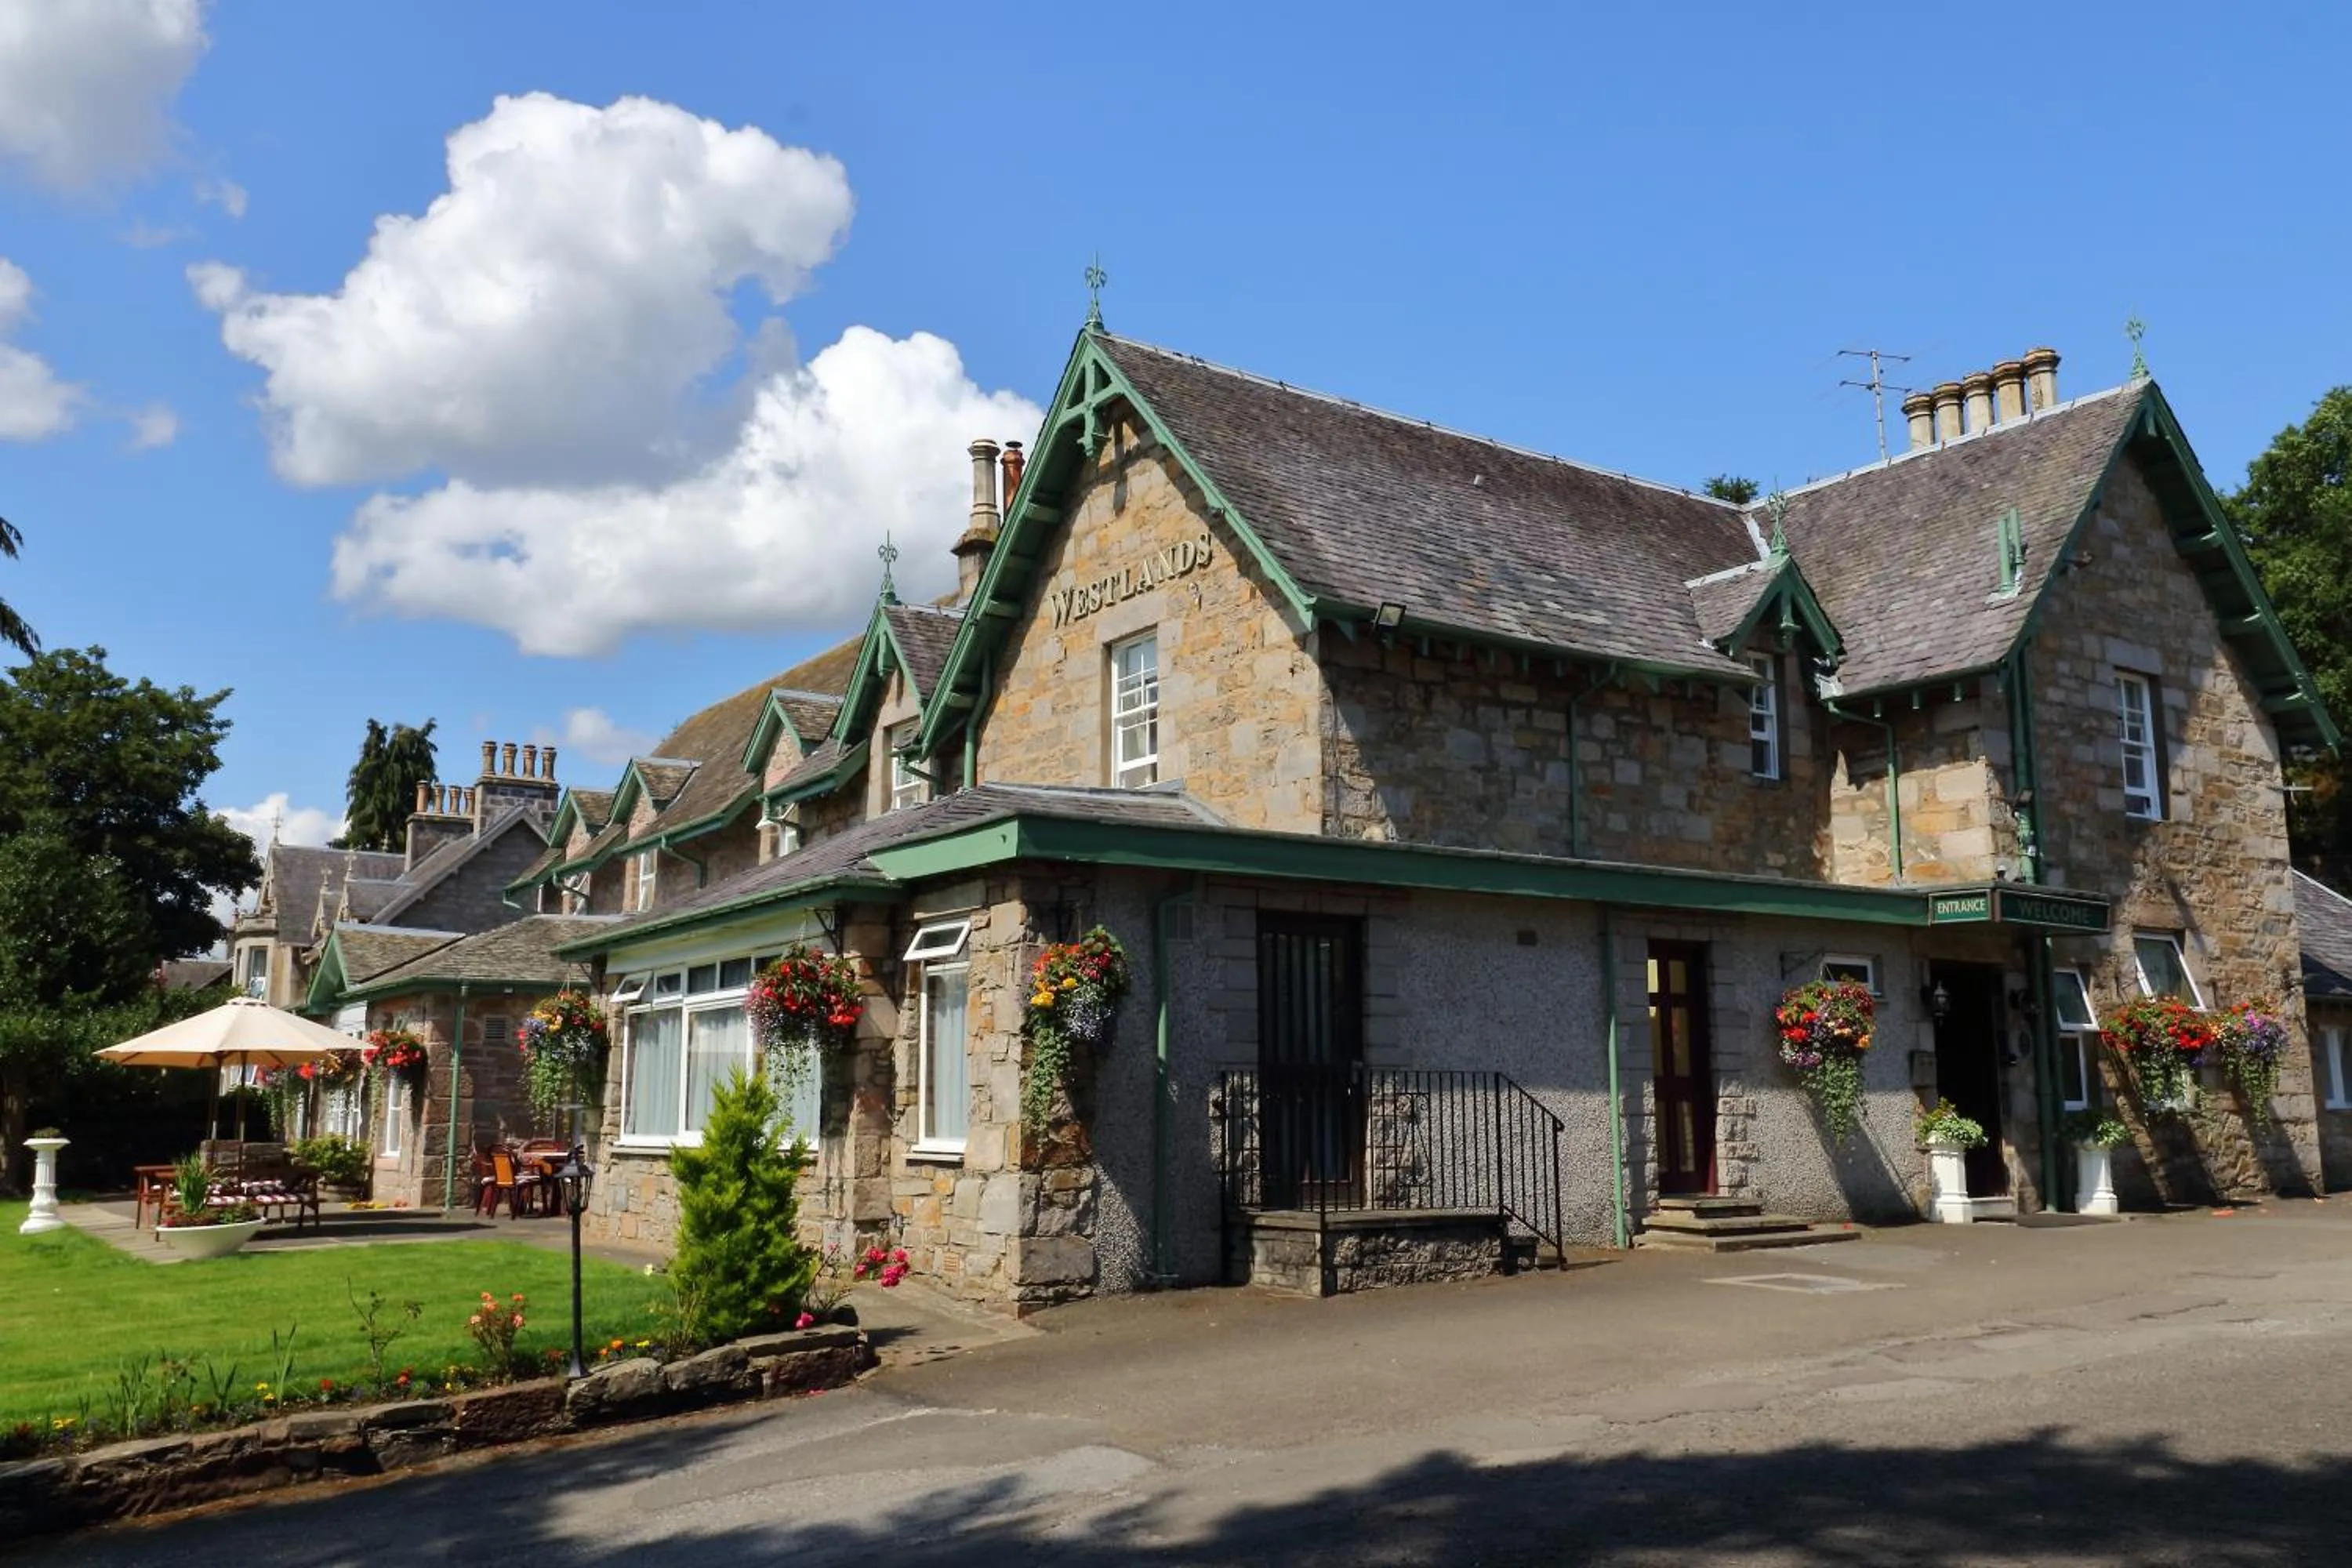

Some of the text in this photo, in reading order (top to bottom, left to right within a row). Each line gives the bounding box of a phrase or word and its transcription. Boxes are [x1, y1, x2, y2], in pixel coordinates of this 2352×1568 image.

[1049, 532, 1213, 628] WESTLANDS
[1937, 898, 1986, 915] ENTRANCE
[2018, 901, 2091, 923] WELCOME
